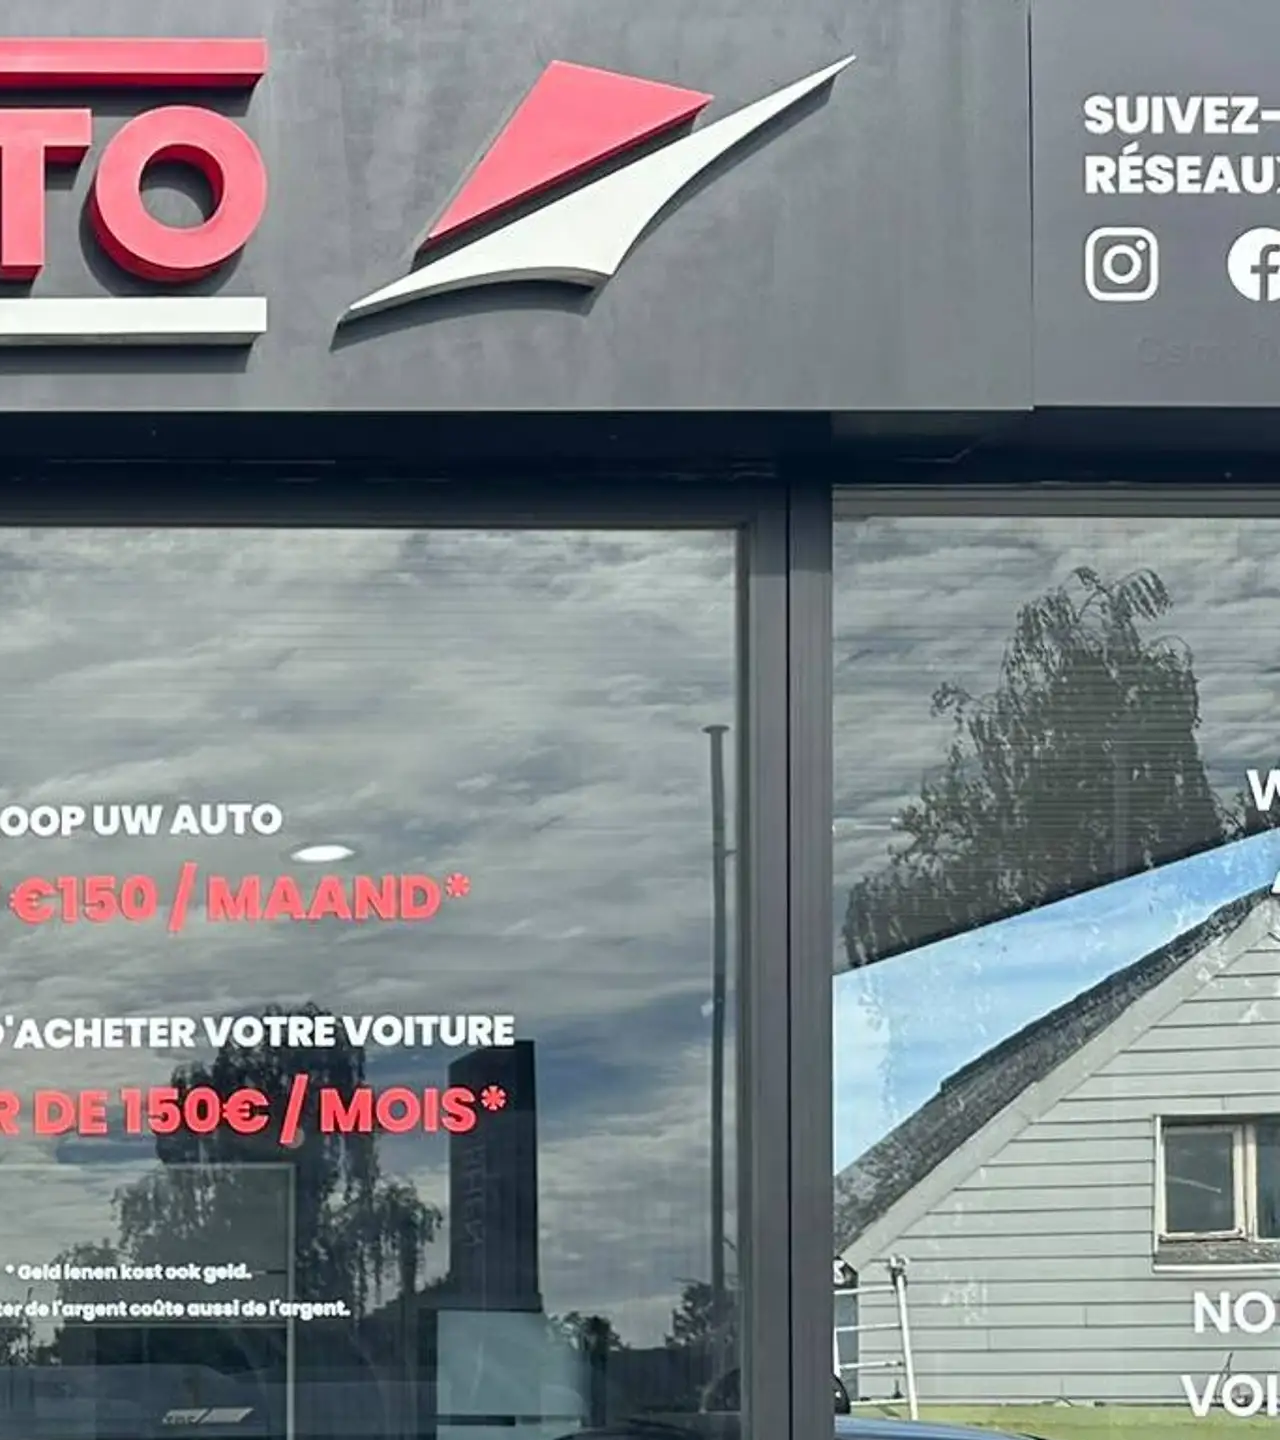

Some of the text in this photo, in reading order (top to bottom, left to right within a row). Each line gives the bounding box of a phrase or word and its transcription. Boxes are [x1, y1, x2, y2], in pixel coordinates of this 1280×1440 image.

[1084, 140, 1280, 194] RÉSEAU
[93, 804, 163, 836] UW
[170, 803, 283, 835] AUTO
[9, 874, 159, 926] €150
[202, 1015, 336, 1048] VOTRE
[341, 1015, 515, 1047] VOITURE
[33, 1089, 108, 1136] DE
[121, 1085, 269, 1134] 150€
[17, 1263, 62, 1281] Geld
[120, 1263, 163, 1281] kost
[165, 1263, 201, 1280] ook
[203, 1263, 253, 1285] geld.
[25, 1300, 49, 1318] de
[51, 1299, 128, 1322] l'argent
[129, 1298, 185, 1317] coûte
[187, 1298, 240, 1317] aussi
[242, 1300, 267, 1317] de
[1193, 1290, 1277, 1334] NO
